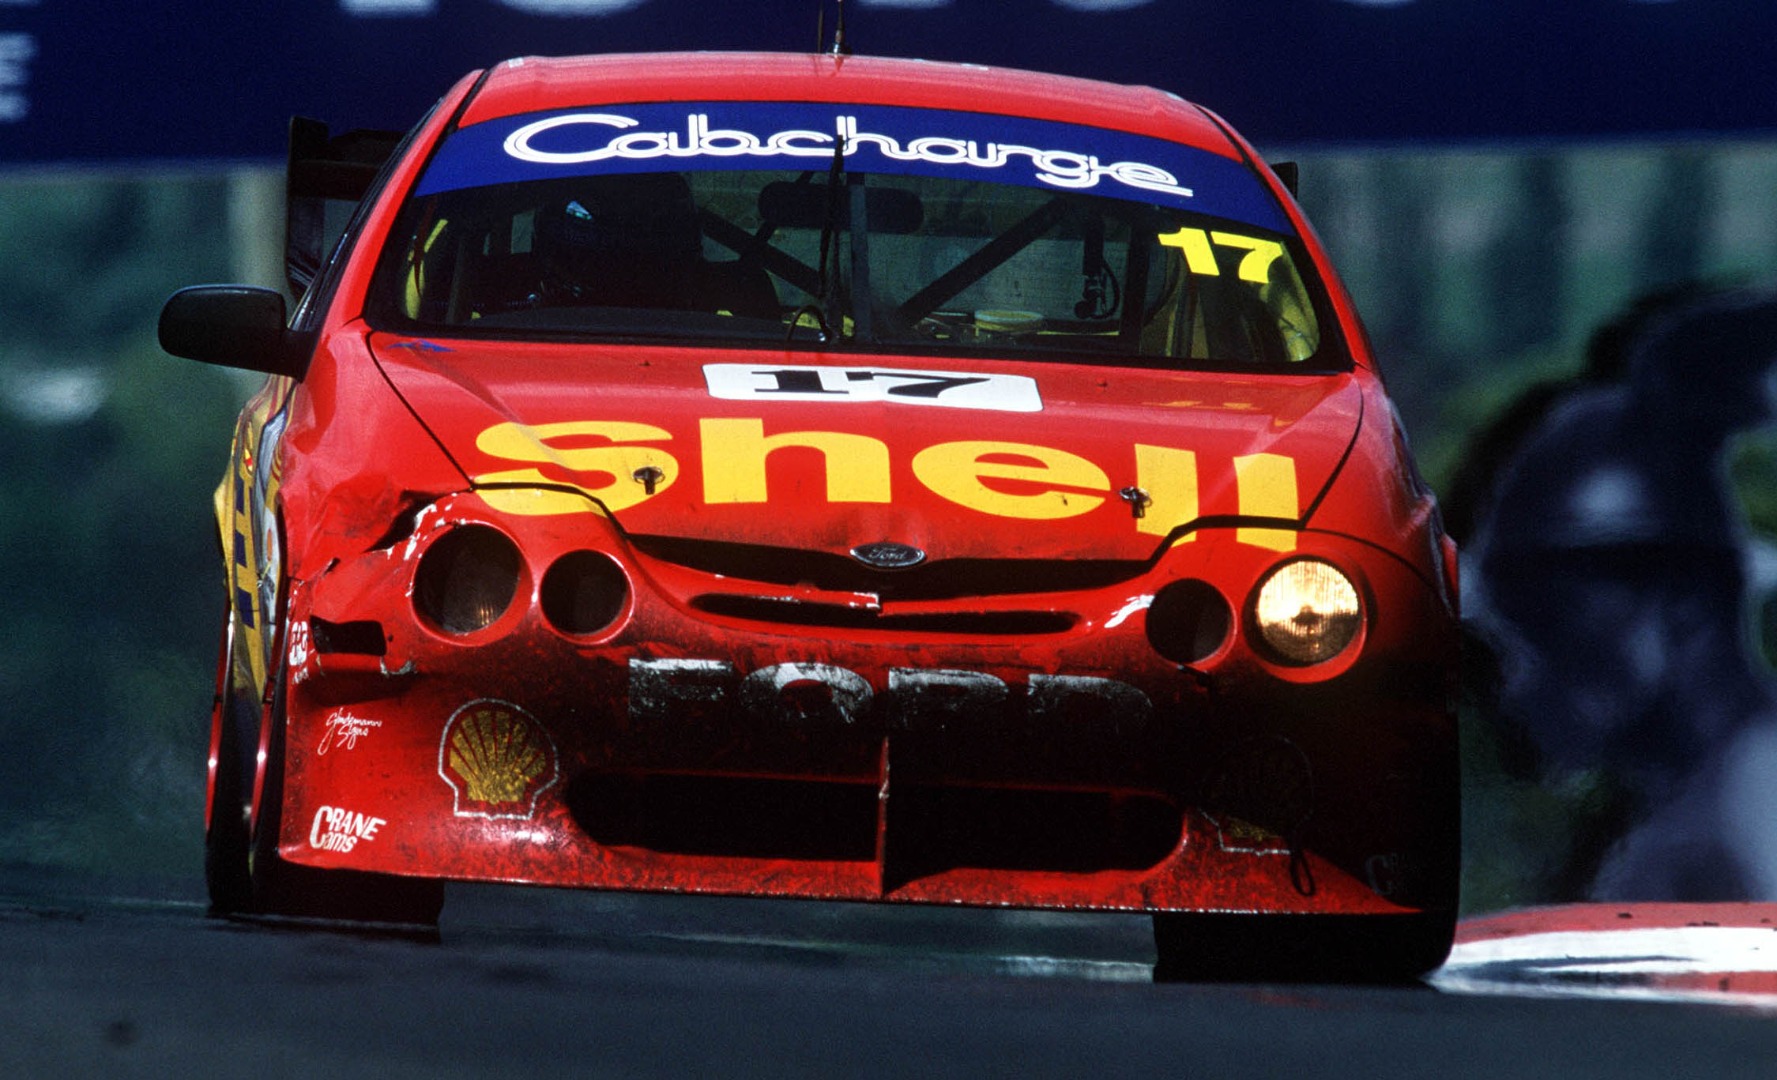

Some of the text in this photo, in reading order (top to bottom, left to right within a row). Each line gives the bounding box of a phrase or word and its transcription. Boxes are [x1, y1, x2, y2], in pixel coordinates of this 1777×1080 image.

[503, 114, 1194, 198] Cabcharge
[1157, 227, 1283, 284] 17
[750, 370, 990, 398] 17
[309, 805, 387, 849] CRANE
